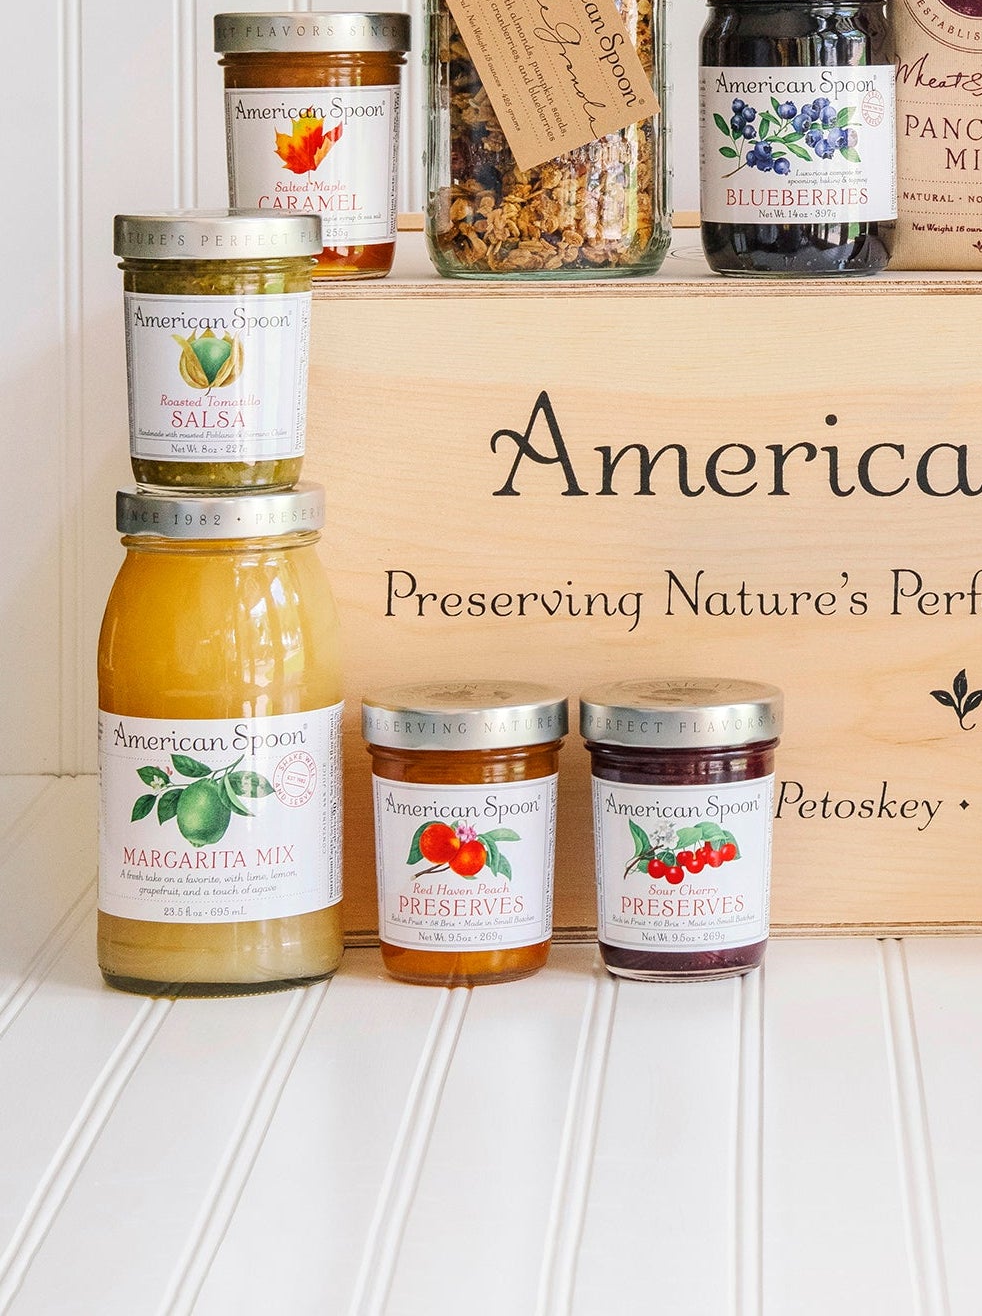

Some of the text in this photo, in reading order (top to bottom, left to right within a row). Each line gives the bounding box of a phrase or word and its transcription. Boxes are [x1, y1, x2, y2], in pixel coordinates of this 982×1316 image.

[245, 26, 334, 38] FLAVORS
[510, 12, 534, 59] almonds,
[528, 61, 554, 105] pumpkin
[715, 71, 816, 94] American
[235, 99, 326, 120] American
[518, 65, 534, 85] and
[528, 85, 556, 142] blueberries
[275, 181, 346, 194] Salted Maple
[726, 188, 869, 206] BLUEBERRIES
[258, 195, 363, 212] CARAMEL
[903, 191, 954, 203] NATURAL
[968, 195, 982, 204] NO
[912, 222, 925, 232] Net
[927, 223, 953, 234] Weight
[955, 225, 965, 233] 16
[134, 306, 227, 329] American
[160, 395, 202, 407] Roasted
[171, 410, 246, 428] SALSA
[174, 514, 221, 525] 1982
[384, 568, 644, 633] Preserving
[663, 568, 869, 618] Nature's
[588, 716, 765, 734] PERFECT FLAVORS
[114, 722, 228, 751] American
[386, 792, 479, 819] American
[605, 792, 701, 819] American
[773, 780, 944, 833] Petoskey
[123, 845, 295, 869] MARGARITA MIX
[145, 873, 162, 882] take
[224, 873, 244, 883] with
[413, 883, 510, 896] Red Haven Peach
[648, 883, 719, 899] Sour Cherry
[399, 895, 525, 917] PRESERVES
[621, 894, 745, 917] PRESERVES
